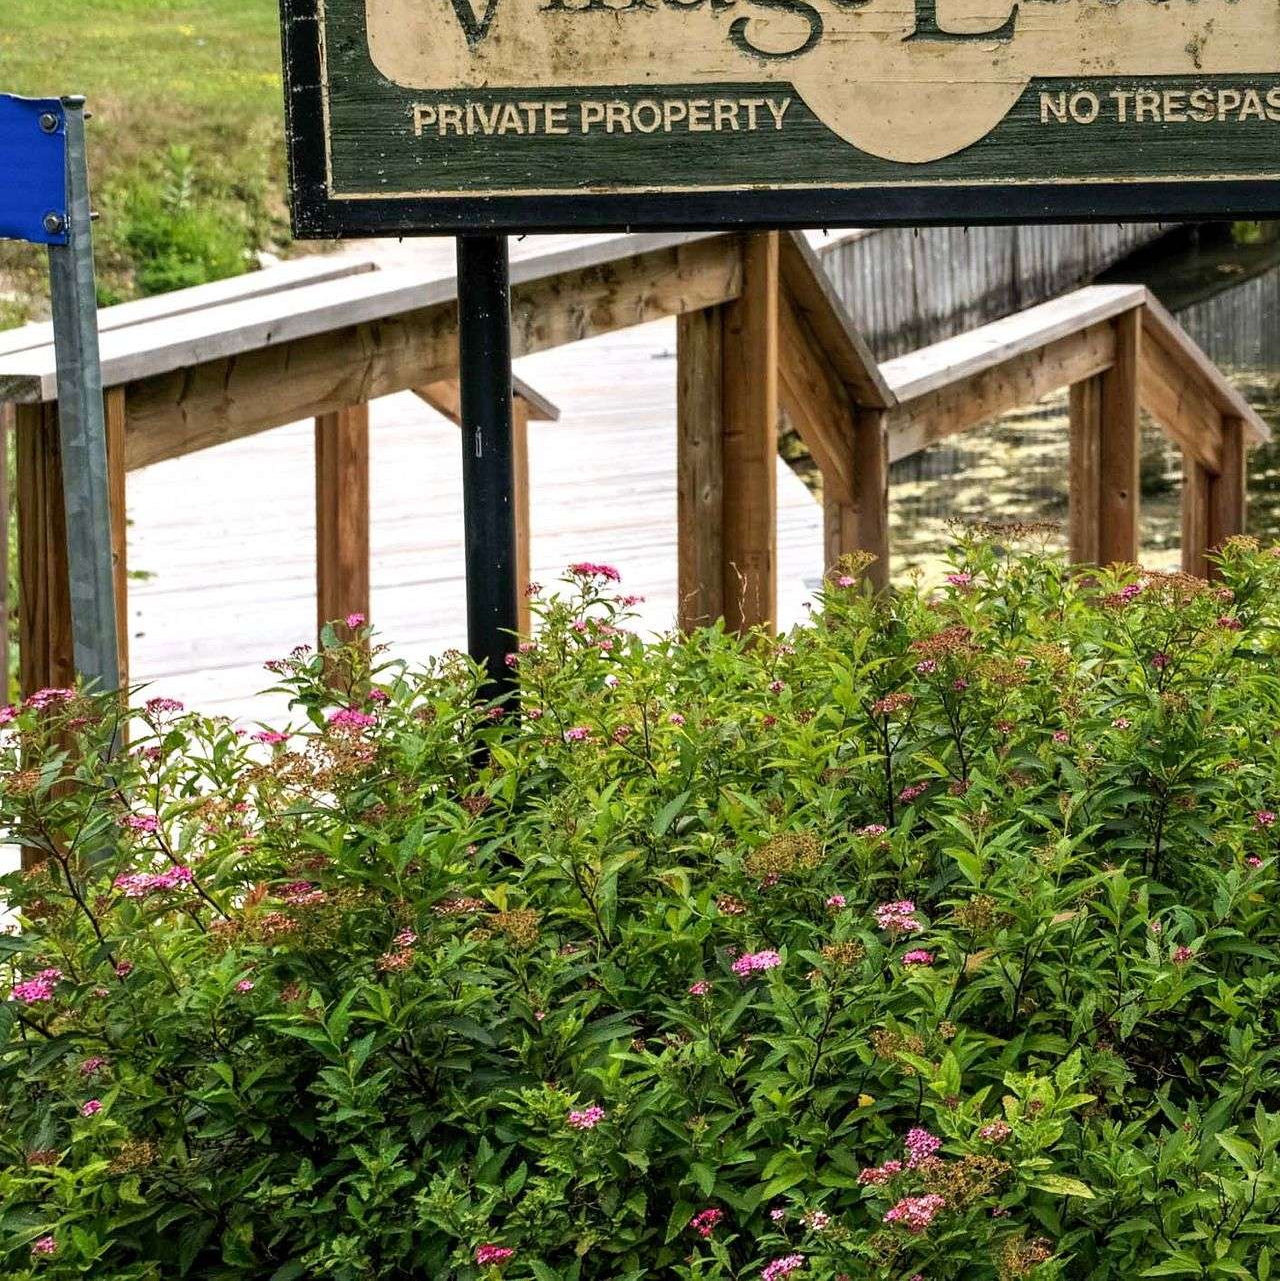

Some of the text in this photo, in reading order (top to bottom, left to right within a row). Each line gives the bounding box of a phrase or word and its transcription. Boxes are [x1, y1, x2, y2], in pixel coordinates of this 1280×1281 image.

[412, 99, 791, 137] PRIVATE PROPERTY
[1039, 90, 1103, 125] NO
